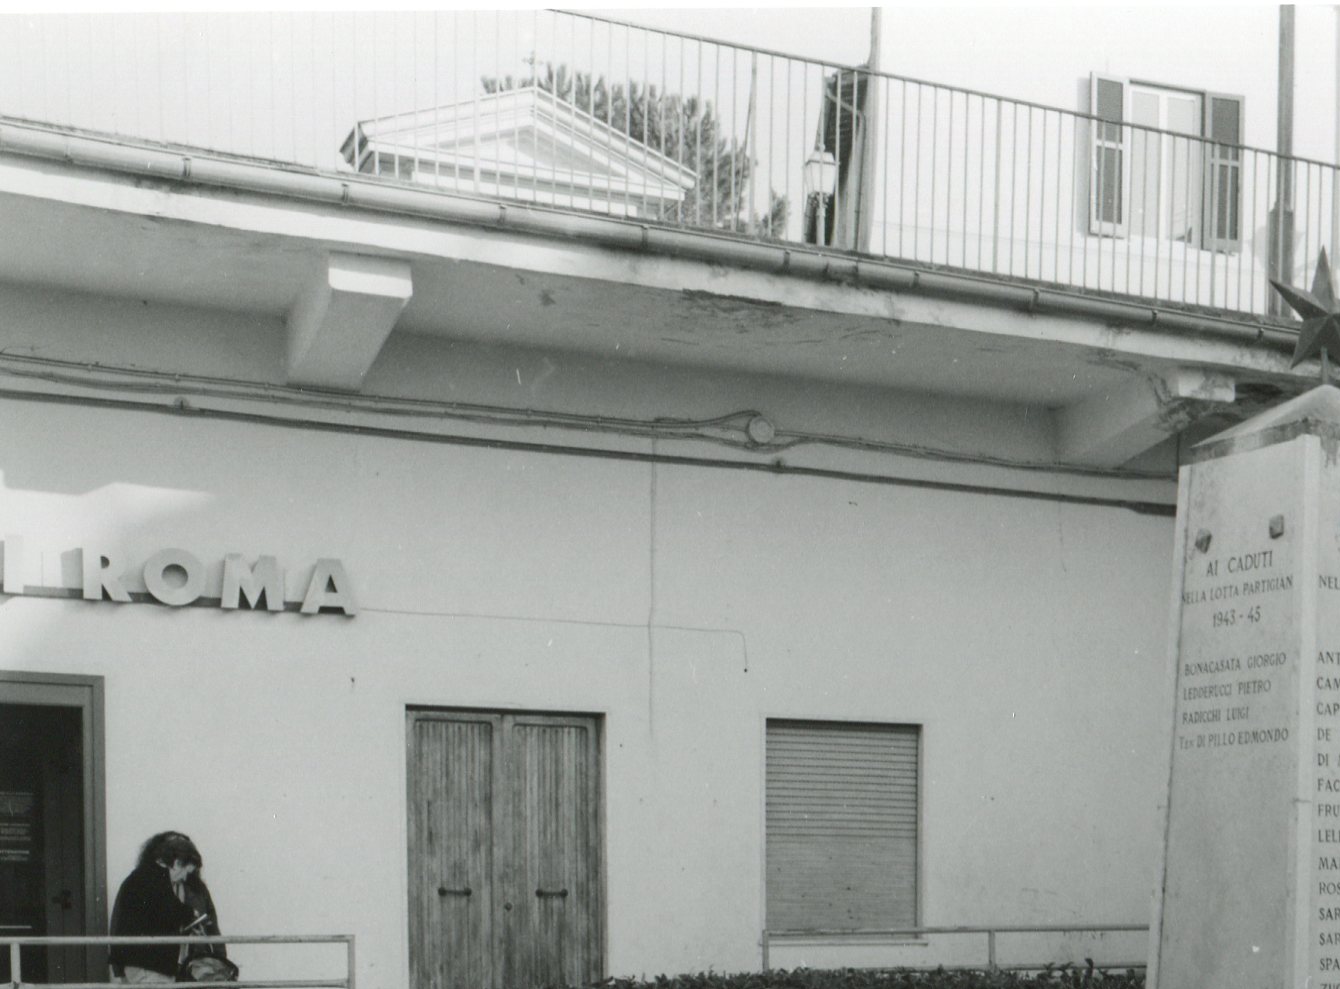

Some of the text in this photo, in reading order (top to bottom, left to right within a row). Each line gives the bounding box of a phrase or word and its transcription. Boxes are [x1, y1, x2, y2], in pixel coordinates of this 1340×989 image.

[1206, 550, 1273, 577] AI CADUTI
[80, 547, 355, 616] ROMA
[1210, 584, 1240, 602] LOTTA
[1212, 608, 1236, 628] 1943
[1247, 605, 1261, 624] 45
[1246, 652, 1286, 670] GIORGIO
[1238, 679, 1272, 696] PIETRO
[1226, 706, 1249, 721] LUIGI
[1196, 734, 1206, 748] DI
[1208, 732, 1236, 748] PILLO
[1238, 728, 1289, 745] EDMONDO
[1317, 728, 1331, 742] DE
[1318, 753, 1328, 767] DI
